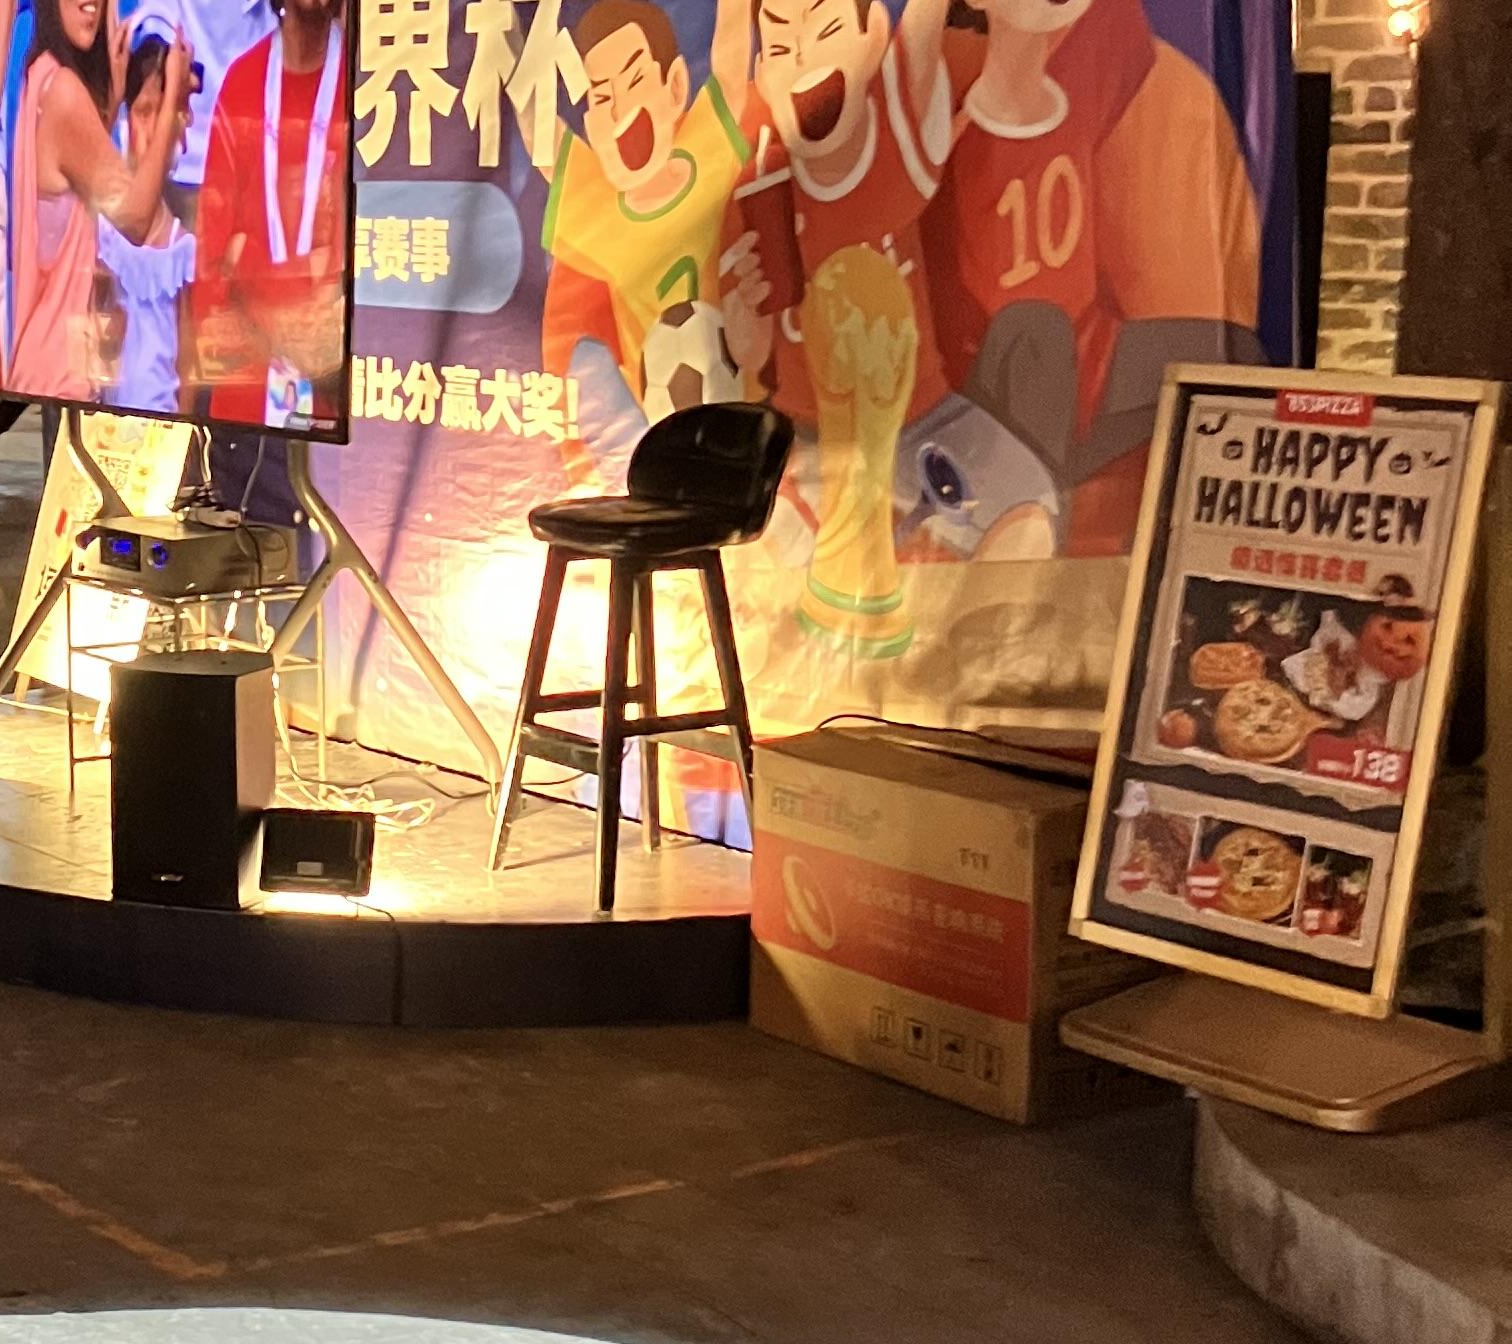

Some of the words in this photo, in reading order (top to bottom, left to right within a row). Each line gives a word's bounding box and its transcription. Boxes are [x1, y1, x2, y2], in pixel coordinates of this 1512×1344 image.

[995, 154, 1083, 289] 10
[1250, 426, 1390, 483] HAPPY
[1194, 476, 1430, 546] HALLOWEEN
